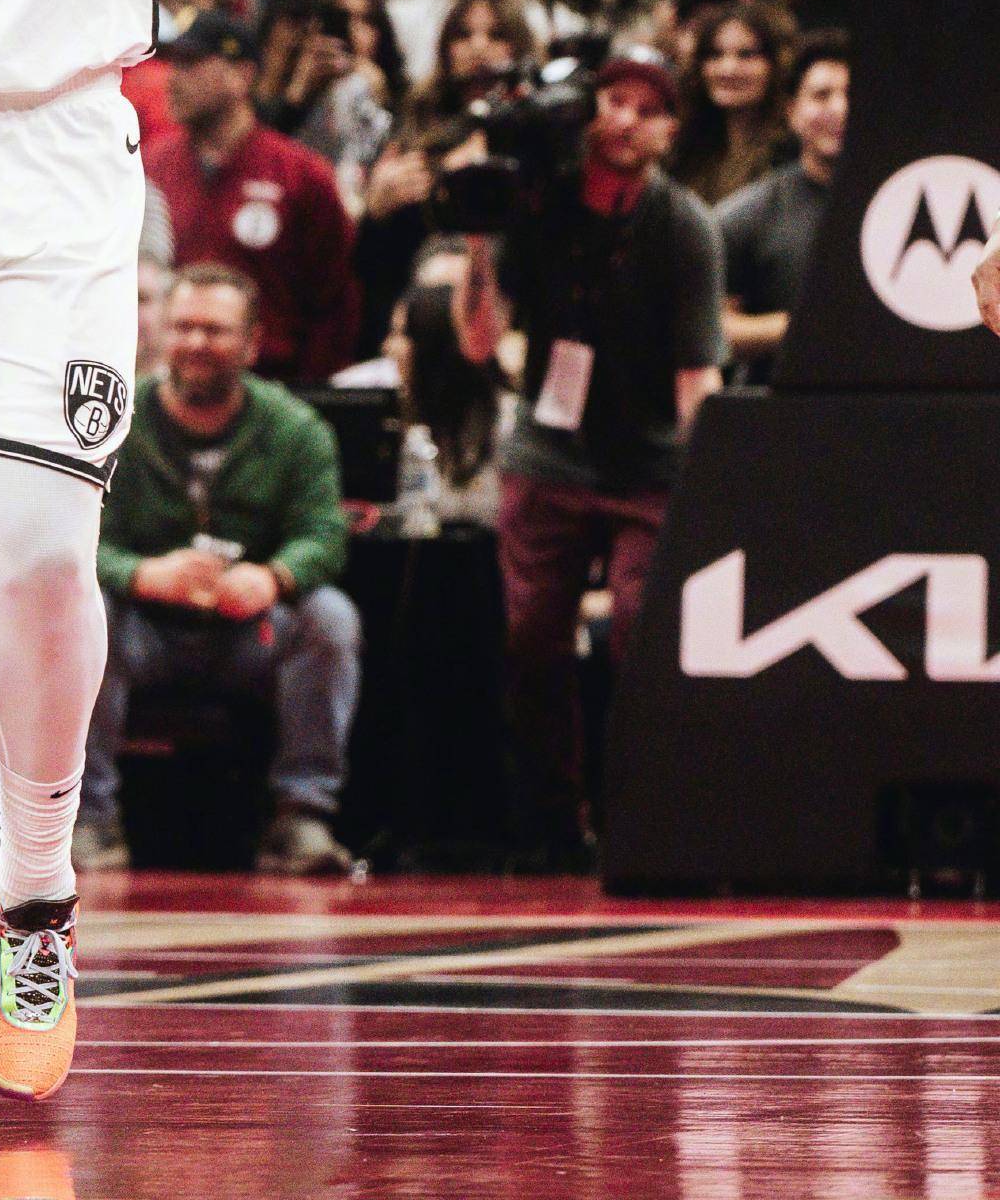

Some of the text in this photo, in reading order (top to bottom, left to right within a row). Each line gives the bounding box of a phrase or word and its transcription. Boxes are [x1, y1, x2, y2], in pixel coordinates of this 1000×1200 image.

[69, 365, 126, 416] NETS
[86, 406, 103, 437] B
[680, 547, 1000, 682] KI
